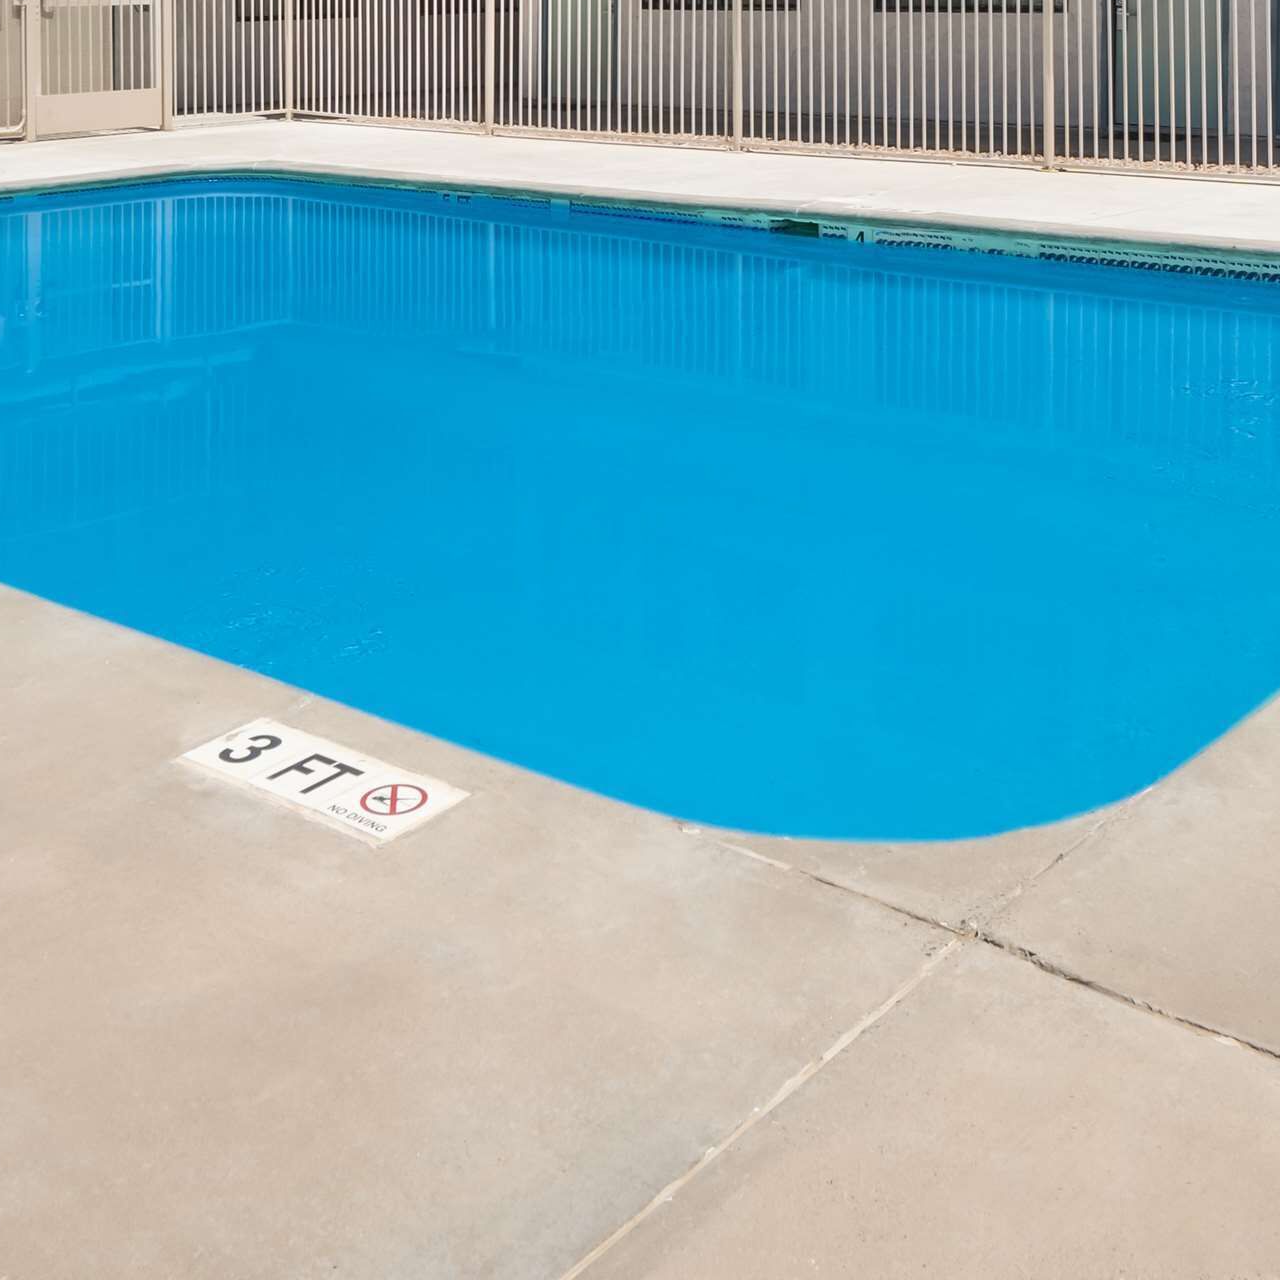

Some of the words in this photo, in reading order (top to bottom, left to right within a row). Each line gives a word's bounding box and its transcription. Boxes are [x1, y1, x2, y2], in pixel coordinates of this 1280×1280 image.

[218, 734, 282, 763] 3
[266, 753, 365, 794] FT
[327, 804, 348, 815] NO
[346, 812, 388, 832] DIVING
